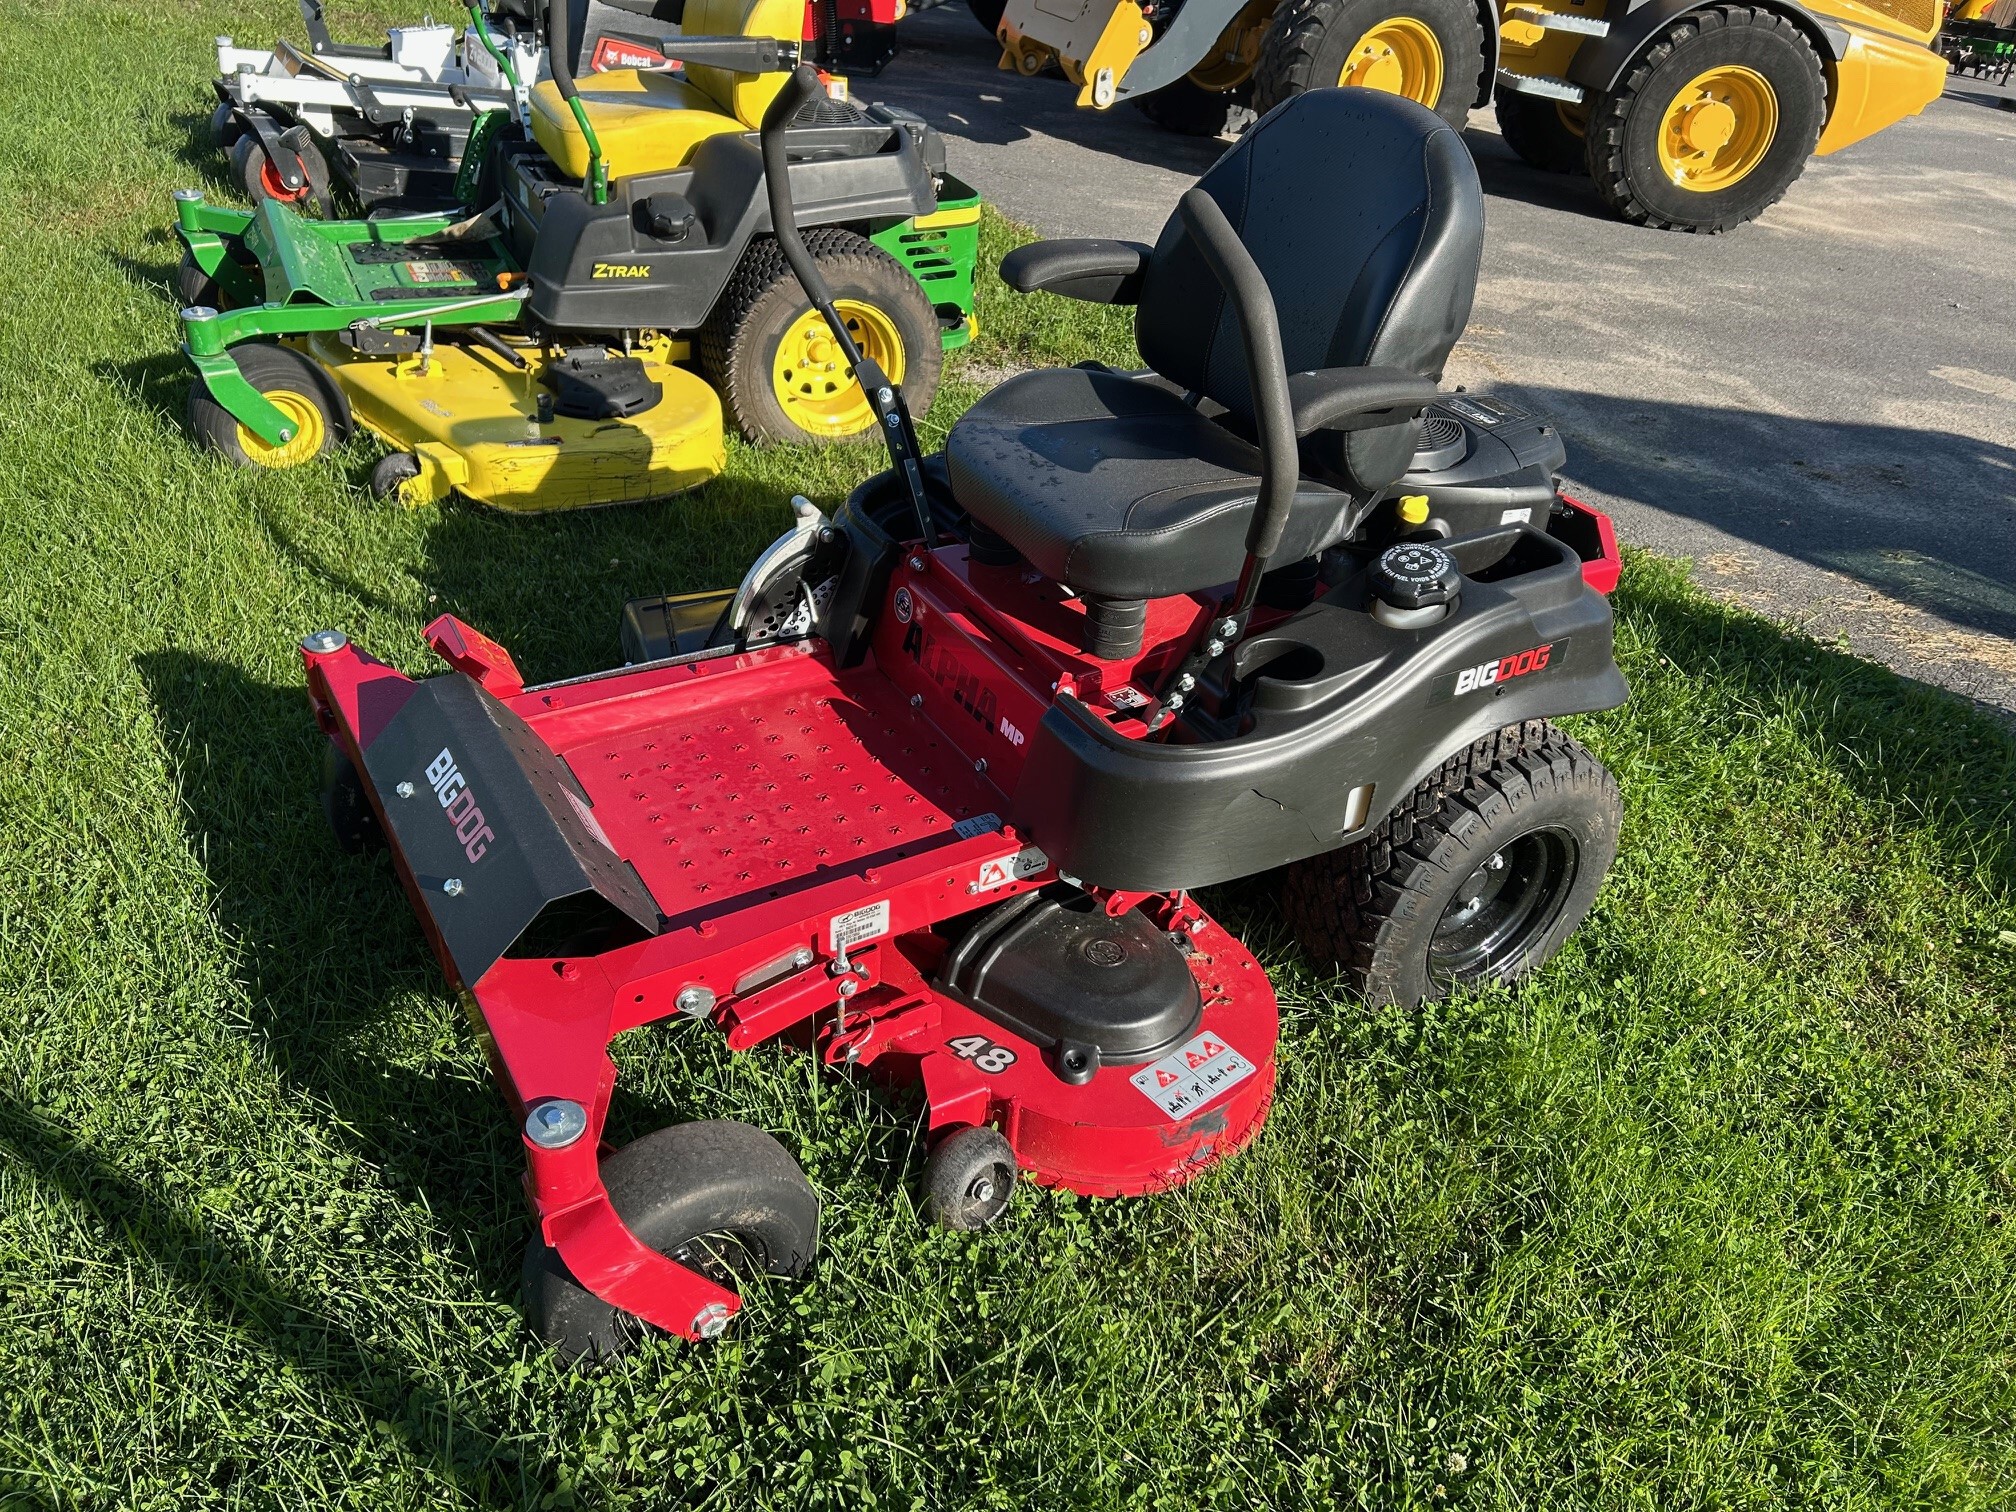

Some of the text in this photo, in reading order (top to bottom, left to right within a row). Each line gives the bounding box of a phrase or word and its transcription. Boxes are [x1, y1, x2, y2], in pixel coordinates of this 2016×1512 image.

[621, 52, 651, 67] Bobcat
[592, 263, 651, 279] ZTRAK
[1454, 645, 1551, 695] BIGDOG
[1000, 717, 1025, 747] MP
[424, 747, 495, 864] BIGDOG
[946, 1034, 1016, 1074] 48
